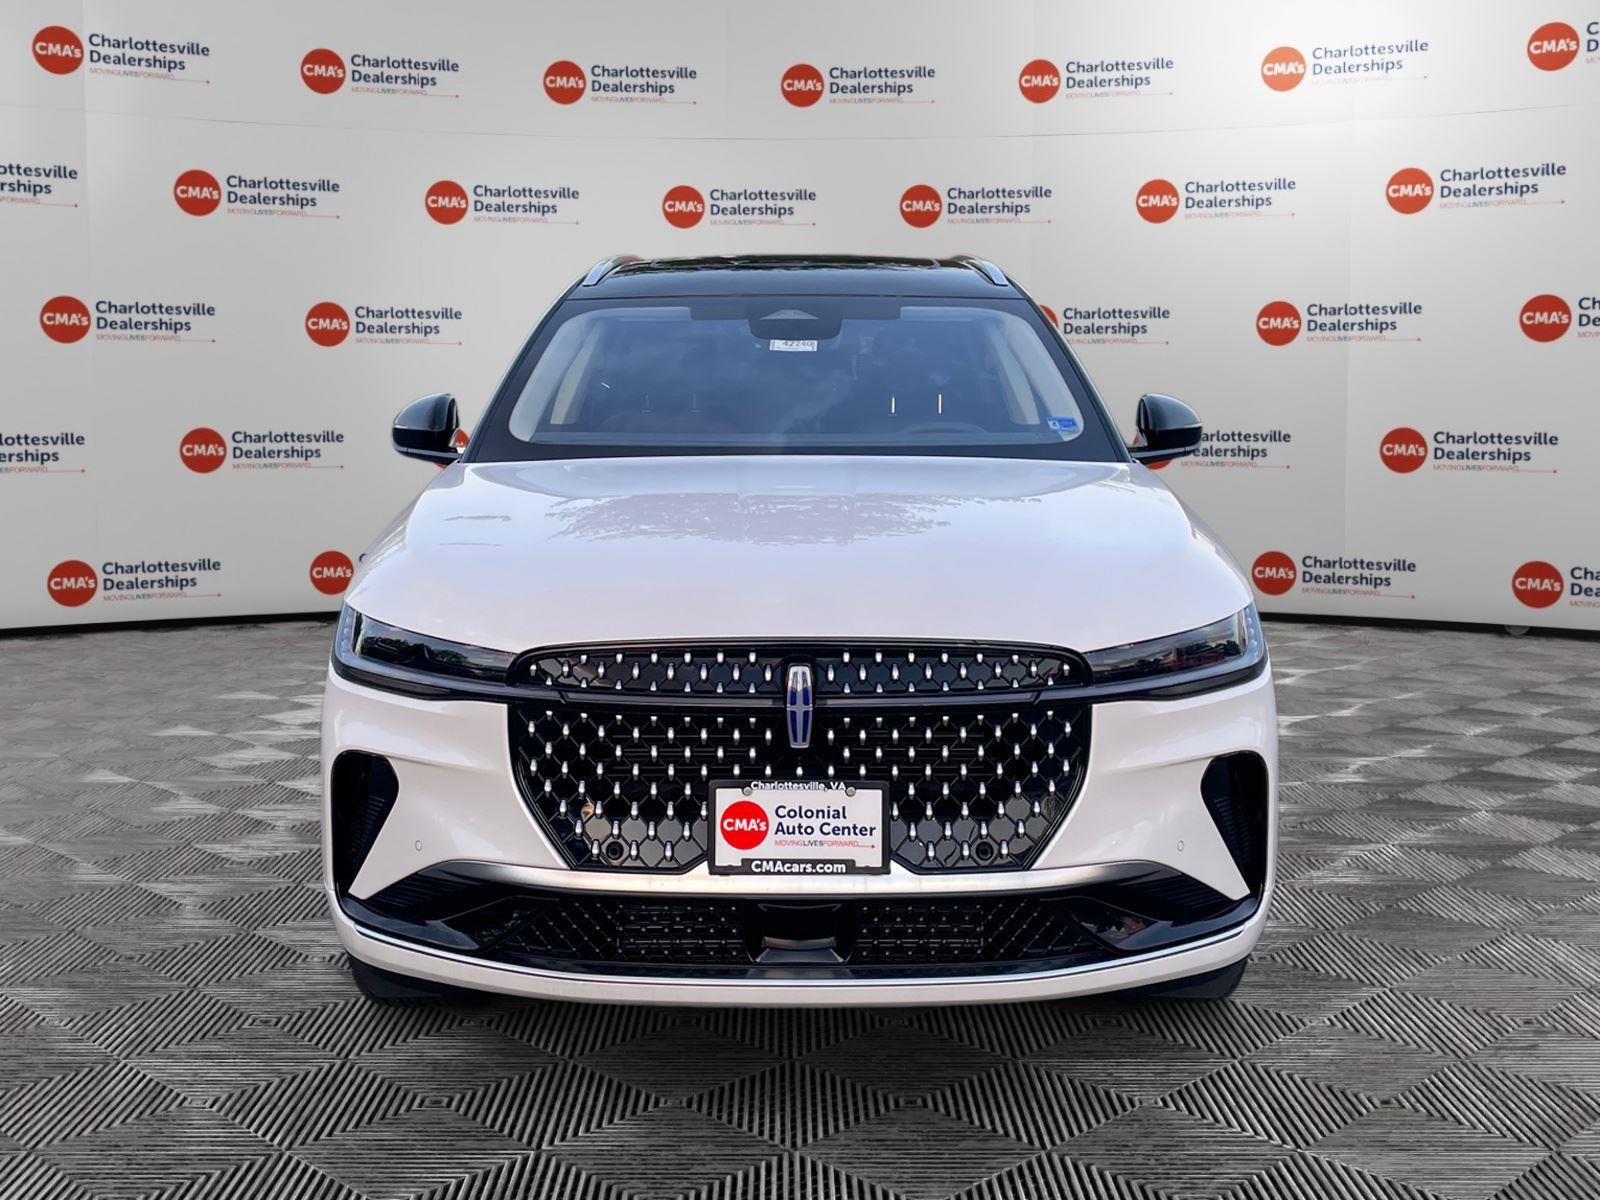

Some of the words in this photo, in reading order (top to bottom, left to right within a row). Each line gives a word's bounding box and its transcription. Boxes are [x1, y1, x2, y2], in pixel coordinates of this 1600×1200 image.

[35, 42, 81, 58] CMA's
[89, 33, 210, 56] Charlottesville
[1312, 39, 1429, 60] Charlottesville
[1530, 38, 1578, 54] CMA's
[90, 50, 185, 73] Dealerships
[351, 54, 459, 72] Charlottesville
[1065, 58, 1173, 74] Charlottesville
[1263, 62, 1304, 76] CMA's
[1313, 59, 1403, 75] Dealerships
[303, 64, 344, 79] CMA's
[351, 69, 437, 89] Dealerships
[591, 65, 697, 79] Charlottesville
[829, 66, 935, 79] Charlottesville
[545, 76, 584, 88] CMA's
[592, 80, 675, 96] Dealerships
[783, 79, 822, 91] CMA's
[1021, 74, 1059, 87] CMA's
[1066, 75, 1150, 89] Dealerships
[830, 81, 913, 96] Dealerships
[1440, 162, 1566, 182] Charlottesville
[226, 175, 340, 192] Charlottesville
[1185, 178, 1296, 194] Charlottesville
[1388, 184, 1432, 197] CMA's
[1440, 182, 1538, 198] Dealerships
[176, 186, 219, 200] CMA's
[473, 185, 579, 199] Charlottesville
[710, 189, 816, 201] Charlottesville
[947, 186, 1052, 200] Charlottesville
[227, 191, 317, 210] Dealerships
[427, 196, 467, 208] CMA's
[664, 201, 703, 212] CMA's
[902, 200, 940, 212] CMA's
[1138, 195, 1178, 207] CMA's
[1185, 195, 1272, 210] Dealerships
[474, 200, 557, 217] Dealerships
[710, 203, 794, 219] Dealerships
[947, 202, 1030, 216] Dealerships
[95, 300, 215, 316] Charlottesville
[355, 306, 462, 320] Charlottesville
[1063, 306, 1170, 320] Charlottesville
[1307, 302, 1422, 317] Charlottesville
[42, 312, 89, 326] CMA's
[96, 316, 191, 334] Dealerships
[307, 318, 348, 330] CMA's
[1258, 317, 1299, 329] CMA's
[1522, 311, 1569, 325] CMA's
[355, 321, 440, 337] Dealerships
[1063, 322, 1148, 337] Dealerships
[1307, 318, 1397, 334] Dealerships
[232, 430, 344, 444] Charlottesville
[1201, 430, 1292, 442] arlottesville
[1433, 431, 1559, 446] Charlottesville
[182, 444, 224, 456] CMA's
[233, 446, 321, 461] Dealerships
[1193, 445, 1267, 460] ealerships
[1382, 444, 1425, 456] CMA's
[1434, 447, 1531, 464] Dealerships
[102, 558, 221, 575] Charlottesville
[1302, 556, 1416, 572] Charlottesville
[312, 566, 352, 579] CMA's
[1254, 567, 1294, 579] CMA's
[1302, 571, 1391, 589] Dealerships
[50, 576, 95, 590] CMA's
[103, 576, 197, 591] Dealerships
[1515, 577, 1561, 591] CMA's
[750, 781, 828, 791] Charlottesville,
[830, 782, 846, 790] VA
[775, 805, 847, 820] Colonial
[723, 818, 767, 832] CMA's
[775, 822, 815, 836] Auto
[820, 822, 876, 837] Center
[751, 861, 846, 873] CMAcars.com
